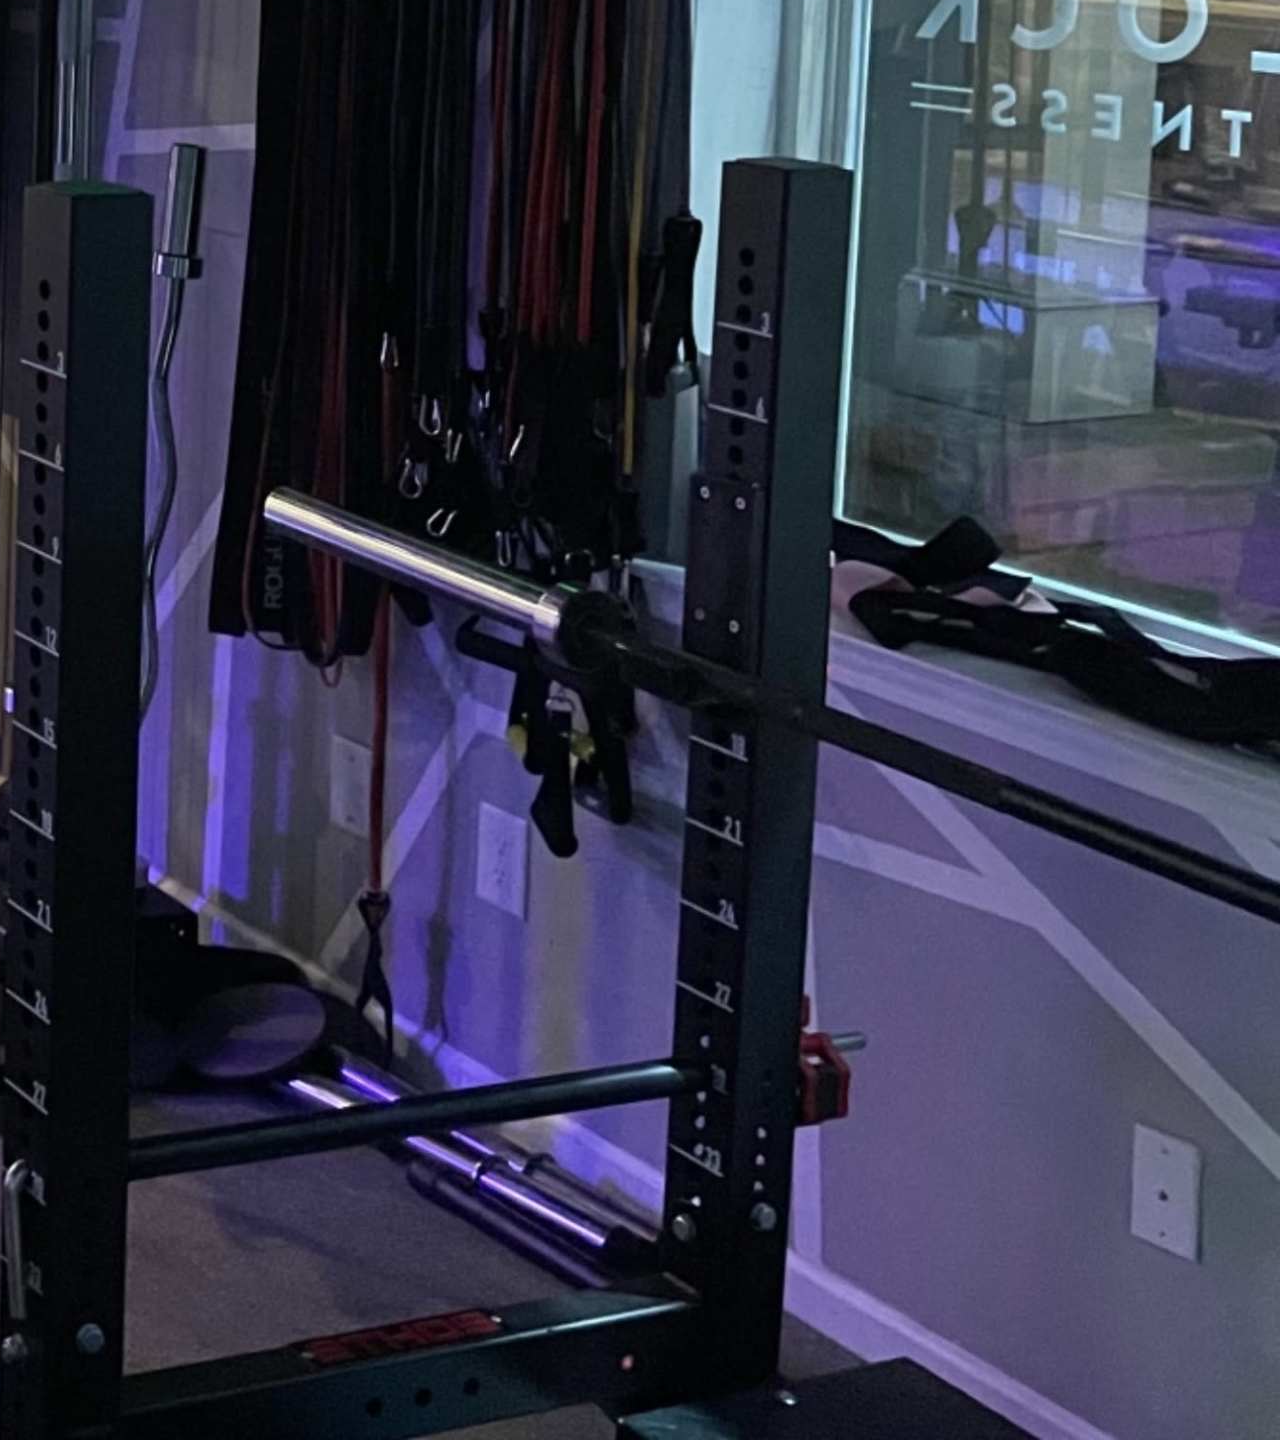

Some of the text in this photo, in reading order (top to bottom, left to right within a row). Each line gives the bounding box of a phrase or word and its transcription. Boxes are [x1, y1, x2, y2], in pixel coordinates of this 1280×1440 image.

[45, 625, 58, 650] 12
[724, 815, 742, 841] 21
[714, 980, 732, 1007] 27
